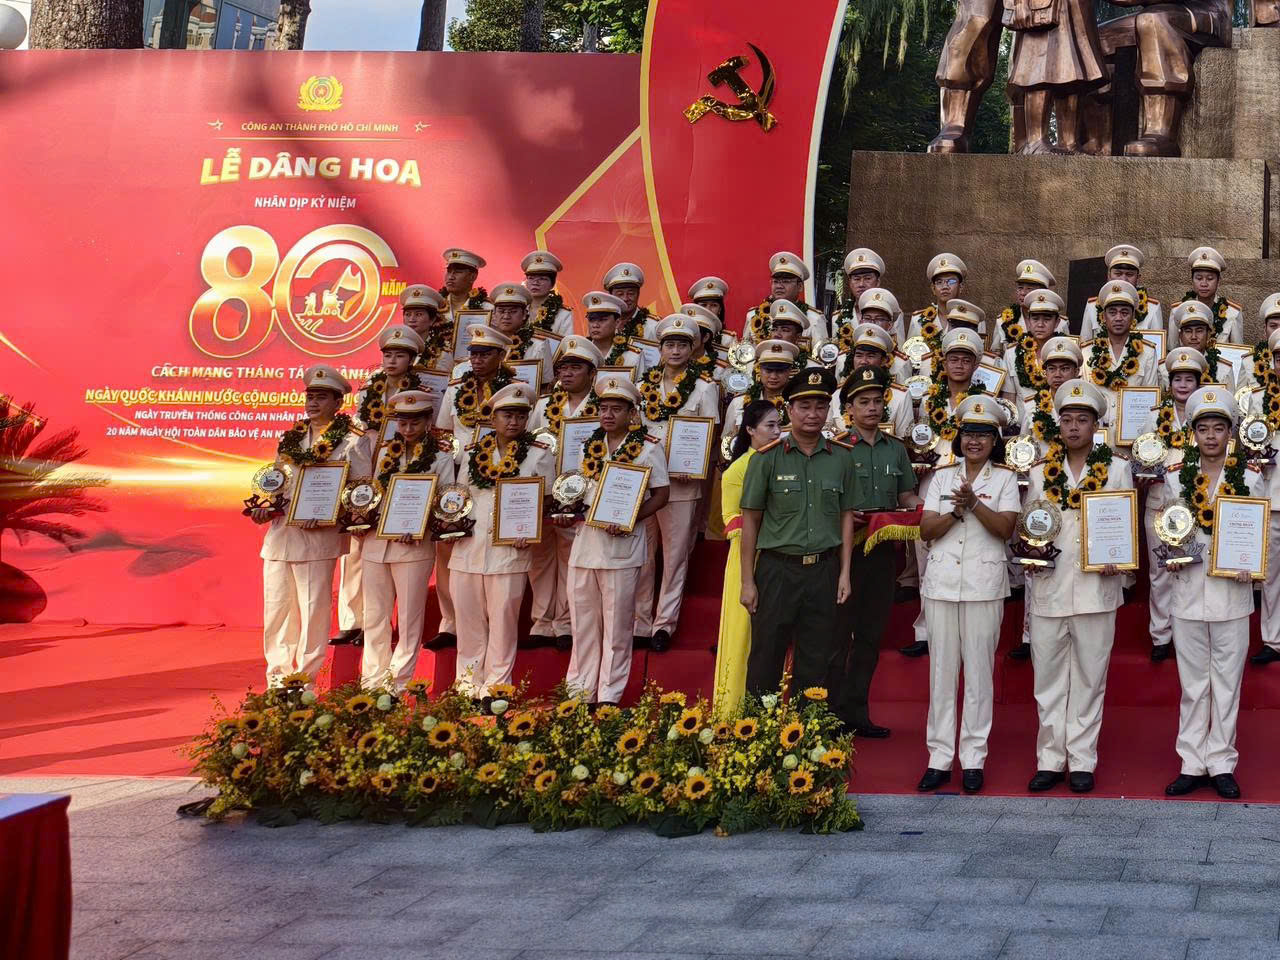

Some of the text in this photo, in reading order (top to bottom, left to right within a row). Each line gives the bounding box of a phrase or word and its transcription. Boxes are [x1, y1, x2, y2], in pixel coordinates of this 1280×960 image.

[241, 121, 267, 132] CÔNG
[269, 123, 286, 132] AN
[285, 121, 317, 132] THÀNH
[356, 121, 371, 132] CHÍ
[374, 123, 399, 132] MINH
[200, 147, 422, 187] LỄ DÂNG HOA
[254, 194, 357, 211] NHÂN DỊP KỶ NIỆM
[381, 278, 407, 296] NĂM
[192, 366, 233, 381] MẠNG
[237, 363, 285, 379] THÁNG
[288, 364, 309, 379] TÁ
[85, 385, 307, 406] NGÀY QUỐC KHÁNH NƯỚC CỘNG HÒA
[135, 409, 158, 419] NGÀY
[160, 410, 194, 420] TRUYỀN
[196, 410, 227, 420] THỐNG
[229, 411, 254, 421] CÔNG
[255, 413, 267, 421] AN
[269, 411, 294, 421] NHÂN
[106, 427, 117, 436] 20
[119, 426, 138, 436] NĂM
[140, 426, 162, 437] NGÀY
[164, 426, 181, 439] HỘI
[183, 426, 206, 437] TOÀN
[208, 427, 227, 437] DÂN
[228, 427, 247, 438] BẢO
[248, 427, 260, 440] VỆ
[260, 429, 273, 439] AN
